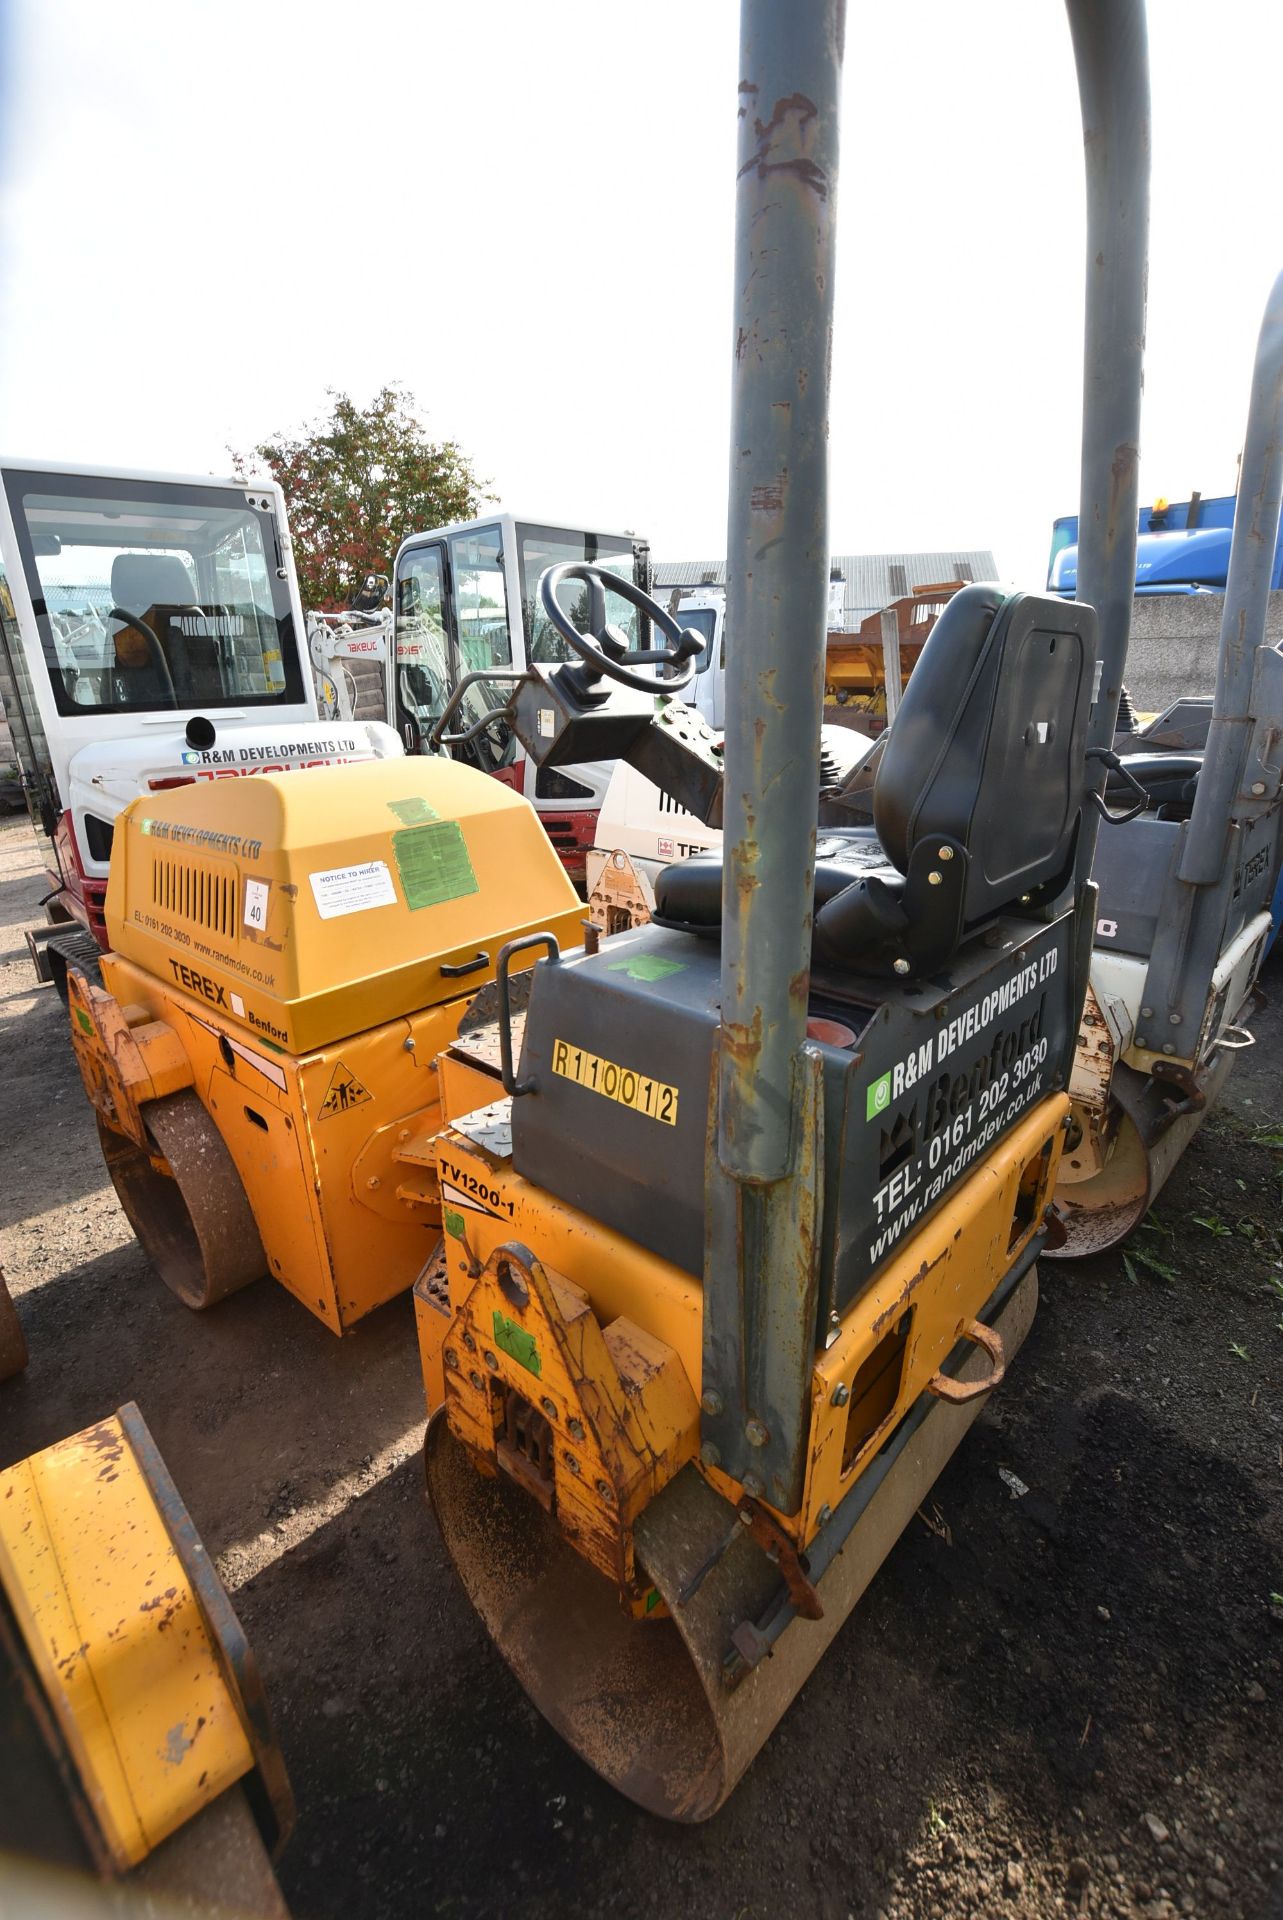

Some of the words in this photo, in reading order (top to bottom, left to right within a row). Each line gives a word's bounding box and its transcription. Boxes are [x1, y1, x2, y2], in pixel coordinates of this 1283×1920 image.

[202, 750, 236, 764] R&M
[240, 741, 336, 761] DEVELOPMENTS
[338, 739, 355, 752] LTD
[150, 820, 171, 839] R&M
[171, 824, 242, 855] DEVELOPMENTS
[242, 838, 262, 860] LTD
[319, 873, 347, 884] NOTICE
[359, 866, 380, 876] HIRER
[250, 905, 261, 922] 40
[145, 915, 160, 931] 0161
[160, 922, 173, 936] 202
[173, 928, 191, 946] 3030
[193, 940, 276, 988] www.randmdev.co.uk
[169, 958, 228, 1010] TEREX
[248, 1011, 288, 1044] Benford
[892, 1037, 934, 1101] R&M
[937, 960, 1038, 1064] DEVELOPMENTS
[1039, 946, 1058, 983] LTD
[555, 1041, 674, 1123] R110012
[872, 1159, 923, 1225] TEL:
[928, 1104, 973, 1170] 0161
[978, 1072, 1009, 1124] 202
[1012, 1036, 1048, 1090] 3030
[440, 1158, 515, 1217] TV1200-1
[869, 1071, 1043, 1265] www.randmdev.co.uk
